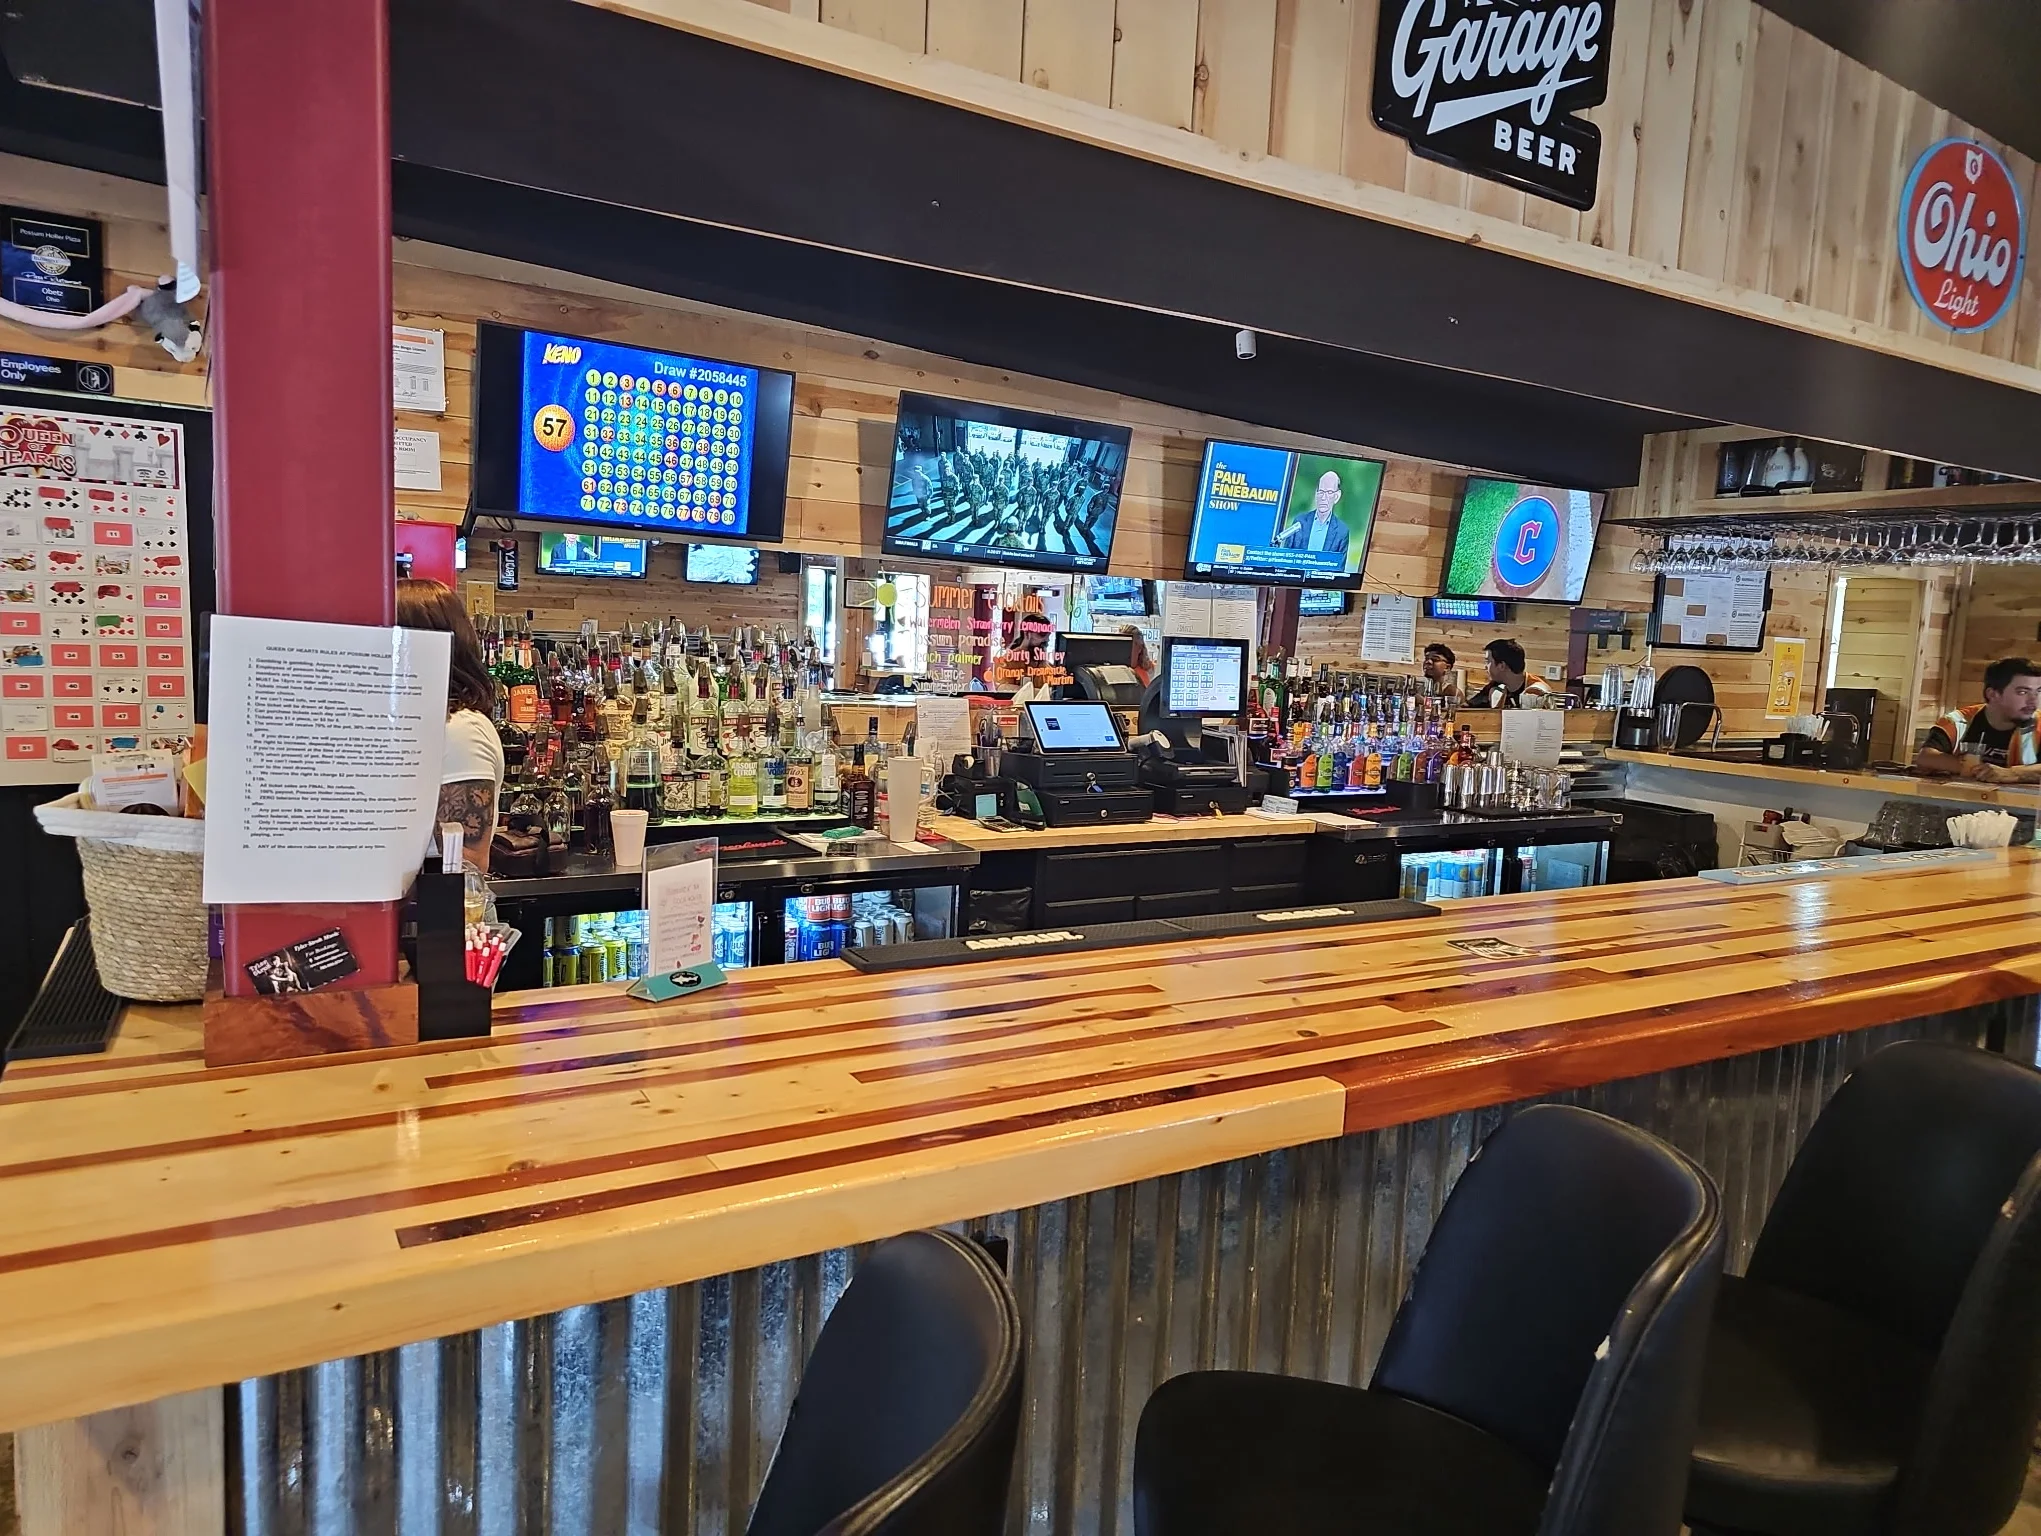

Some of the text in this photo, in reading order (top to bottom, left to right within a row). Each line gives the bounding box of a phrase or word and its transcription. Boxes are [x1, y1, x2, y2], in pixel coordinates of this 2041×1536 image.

[1391, 0, 1602, 126] Garage
[1493, 119, 1577, 175] BEER
[20, 228, 44, 237] Possum
[1913, 181, 2011, 287] Ohio
[42, 287, 63, 296] Obetz
[1933, 278, 1979, 319] Light
[542, 343, 581, 364] KENO
[1, 358, 61, 374] Employees
[1, 369, 27, 382] Only
[654, 362, 747, 387] Draw #2058445
[591, 373, 741, 404] 1 2 3 4 5 6 7 8 9 10
[587, 391, 740, 421] 11 12 13 14 15 16 17 18 19 20
[542, 417, 567, 437] 57
[587, 409, 739, 438] 21 22 23 24 25 26 27 28 29 30
[0, 424, 76, 447] QUEEN
[586, 427, 738, 455] 31 32 33 34 35 36 37 38 39 40
[27, 443, 47, 451] OF
[0, 451, 77, 475] HEARTS
[585, 445, 737, 472] 41 42 43 44 45 46 47 48 49 50
[1215, 461, 1227, 470] the
[584, 463, 736, 489] 51 52 53 54 55 56 57 58 59 60
[1213, 470, 1248, 486] PAUL
[583, 480, 735, 505] 61 62 63 64 65 66 67 68 69 70
[1211, 483, 1279, 502] FINEBAUM
[583, 498, 734, 522] 71 72 73 74 75 76 77 78 79 80
[1208, 500, 1240, 511] SHOW
[1514, 520, 1542, 566] C
[915, 581, 1045, 613] Summer Cocktails
[959, 634, 1006, 648] paradise
[947, 652, 983, 669] palmer
[1006, 649, 1030, 664] Dirty
[996, 666, 1025, 680] Orange
[513, 688, 538, 696] JAMES
[811, 904, 831, 912] LIGH
[815, 898, 831, 906] BUD
[833, 897, 851, 905] BUD
